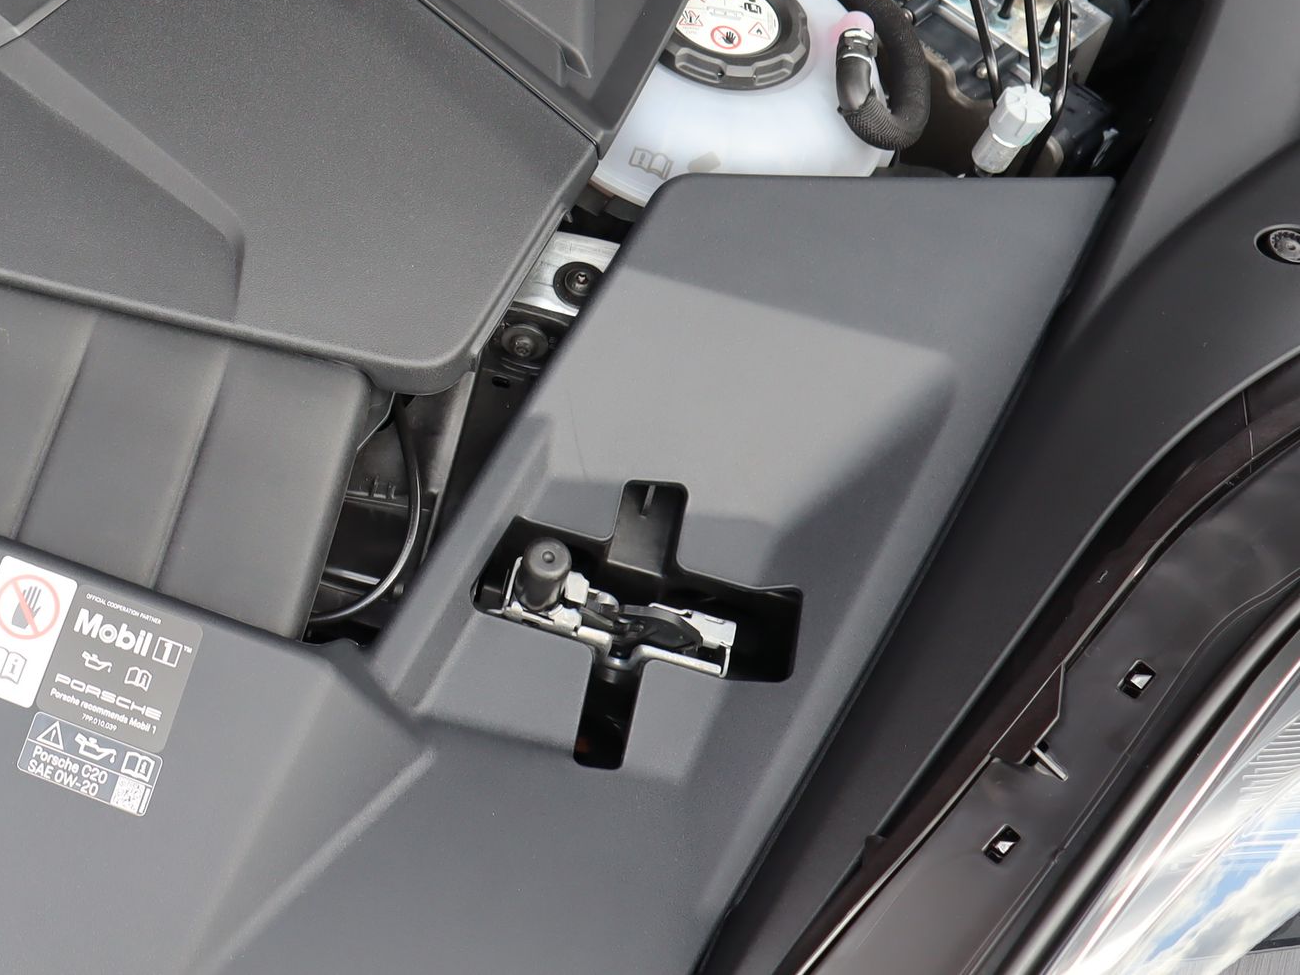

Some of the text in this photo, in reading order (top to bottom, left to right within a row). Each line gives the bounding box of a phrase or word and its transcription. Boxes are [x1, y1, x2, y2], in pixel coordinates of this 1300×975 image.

[86, 593, 161, 625] OFFICIAL COOPERATION PARTNER
[74, 608, 153, 657] Mobil
[50, 688, 157, 735] Porsche recommends Mobil 1
[55, 673, 162, 721] PORSCHE
[27, 759, 99, 797] SAE 0W-20
[32, 745, 108, 784] Porsche C20
